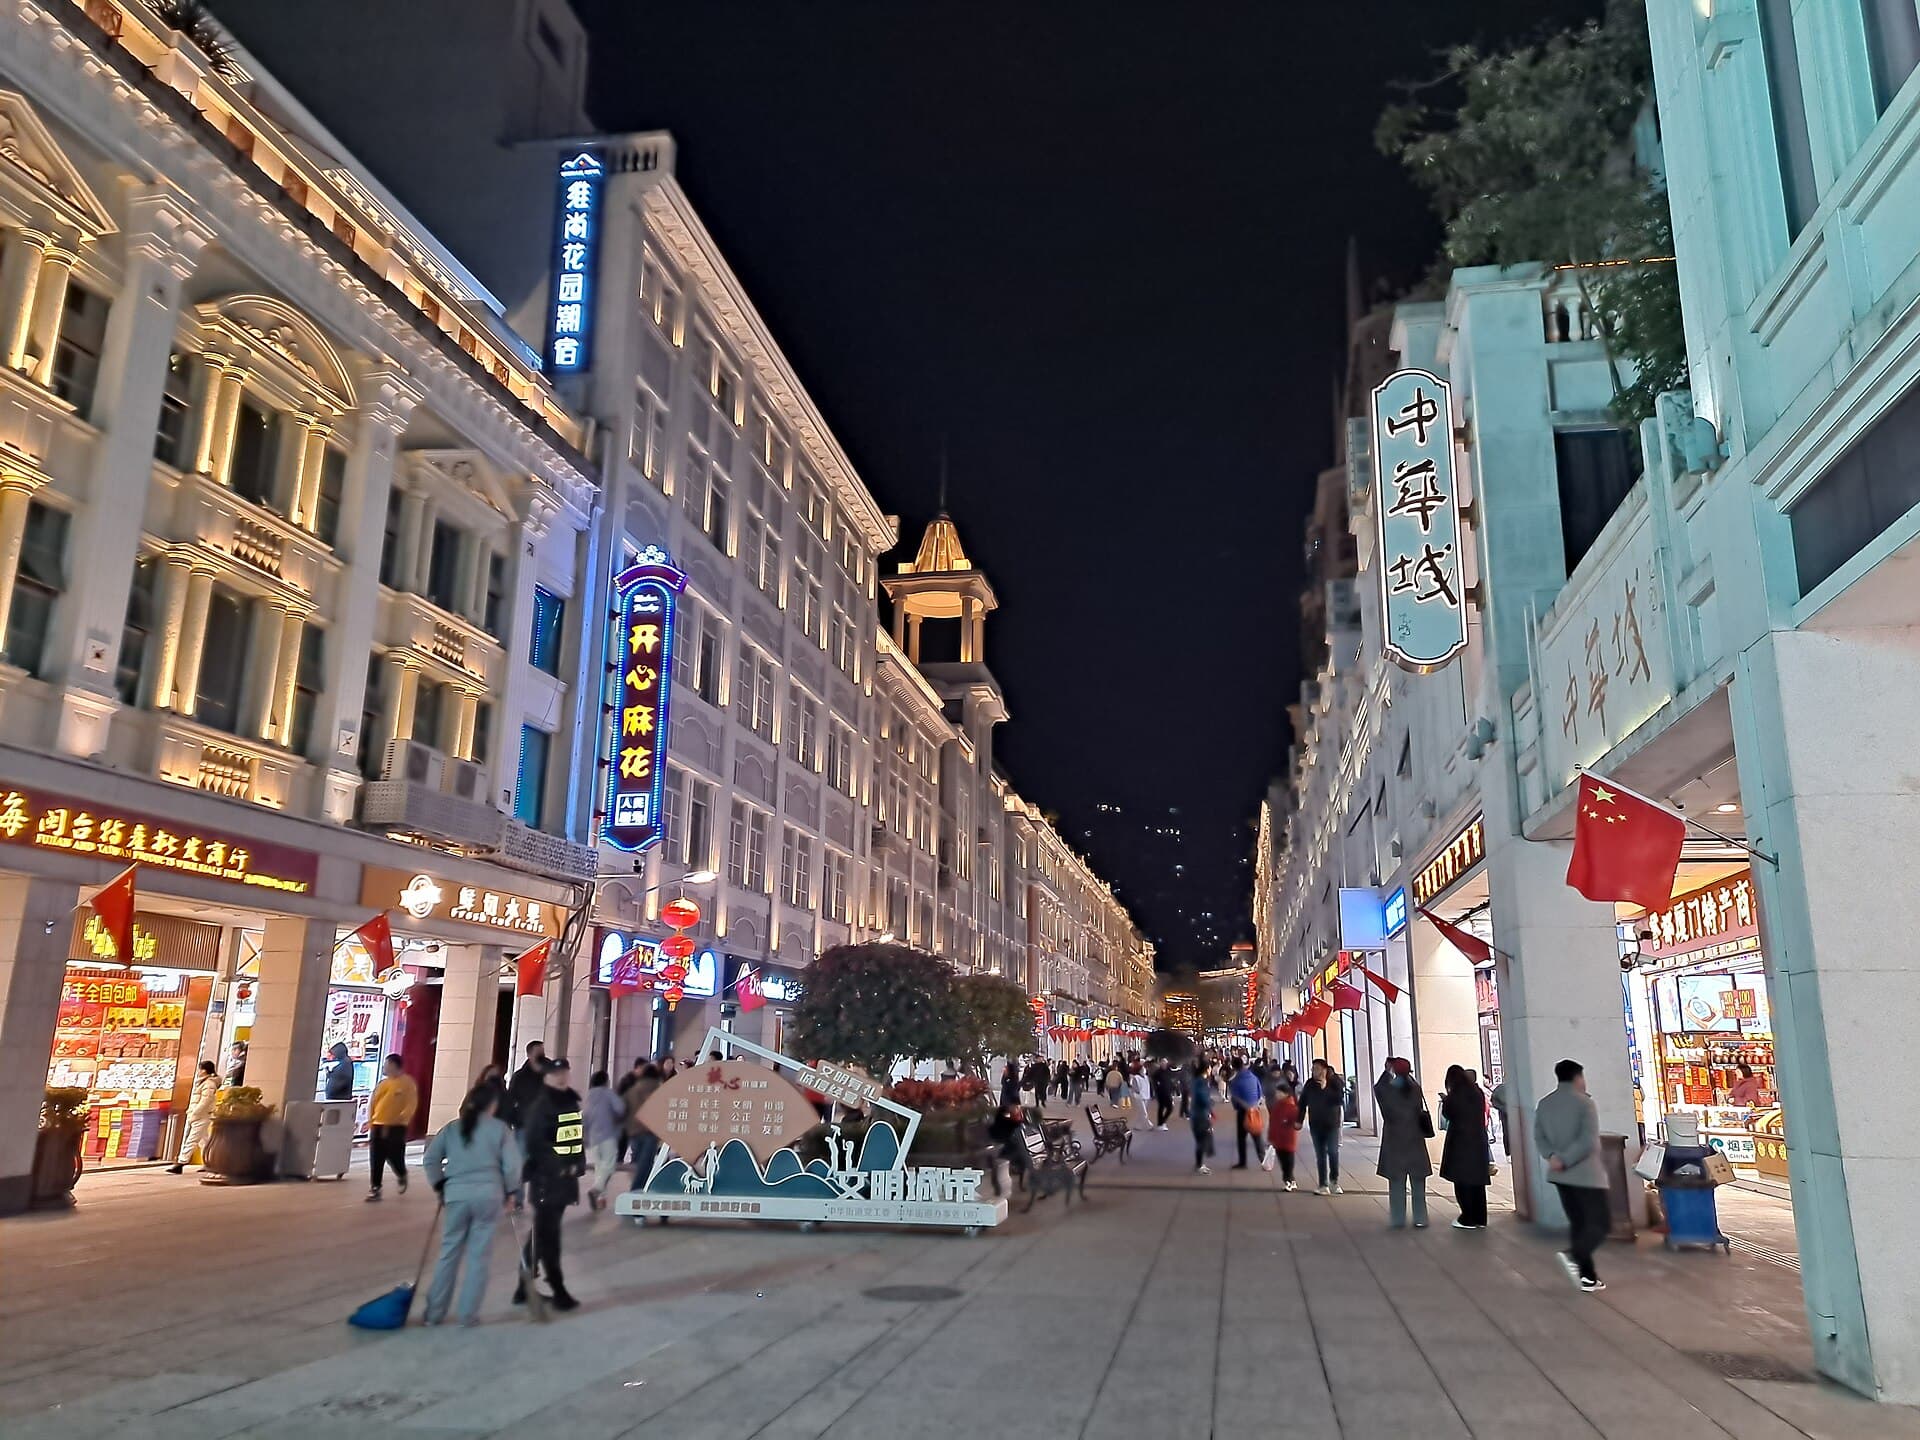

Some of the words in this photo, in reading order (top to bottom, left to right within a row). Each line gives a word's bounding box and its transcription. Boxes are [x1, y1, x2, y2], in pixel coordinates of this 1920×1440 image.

[620, 624, 659, 779] 开心麻花
[834, 1167, 984, 1202] 文明城市
